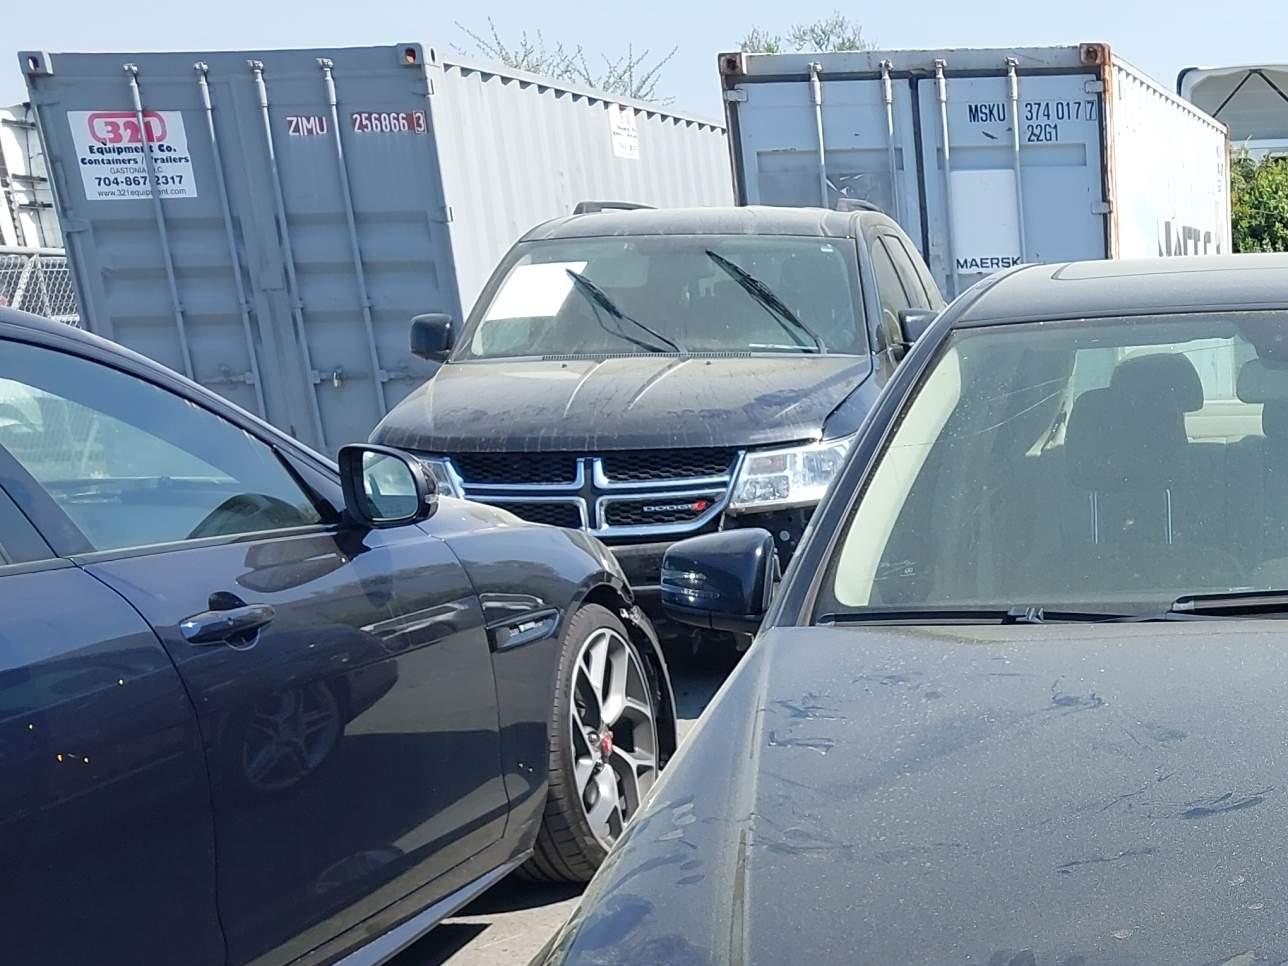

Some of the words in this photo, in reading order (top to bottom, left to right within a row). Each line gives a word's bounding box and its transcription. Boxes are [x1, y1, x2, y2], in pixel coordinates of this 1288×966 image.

[968, 103, 1006, 122] MSKU
[104, 120, 155, 143] 321
[286, 116, 327, 136] ZIMU
[1026, 123, 1058, 142] 22G1
[88, 144, 154, 154] Equipmet
[158, 144, 177, 153] Co.
[81, 157, 138, 166] Containers
[151, 155, 189, 165] railers
[95, 175, 183, 187] 704-8672317
[97, 187, 187, 197] www.321equipnt.com
[956, 257, 1020, 269] MAERSK
